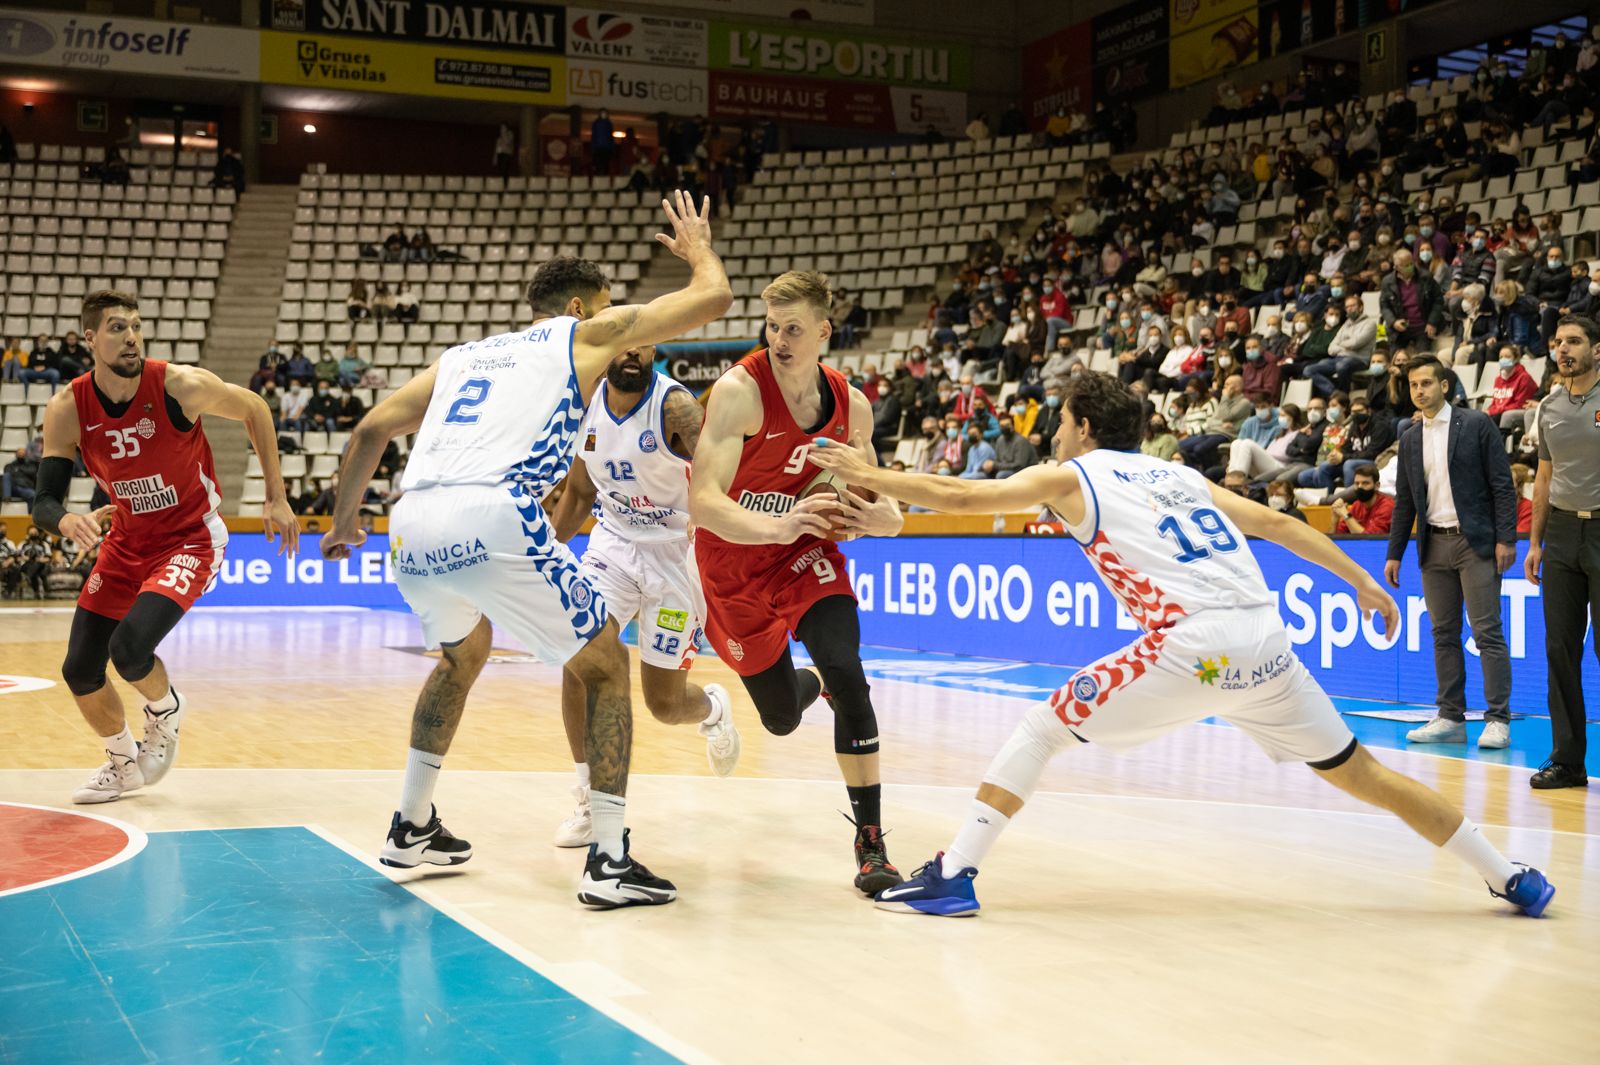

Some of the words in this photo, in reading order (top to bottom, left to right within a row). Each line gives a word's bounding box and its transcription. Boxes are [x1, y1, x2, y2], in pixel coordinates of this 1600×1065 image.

[321, 0, 411, 35] SANT
[425, 4, 557, 47] DALMAI
[62, 19, 191, 56] infoself
[572, 41, 633, 57] VALENT
[61, 51, 110, 67] group
[319, 47, 371, 64] Grues
[729, 31, 949, 83] L'ESPORTIU
[319, 64, 386, 82] Viñolas
[608, 73, 703, 103] fustech
[718, 84, 827, 108] BAUHAUS
[909, 94, 923, 123] 5
[443, 377, 495, 425] 2
[105, 427, 141, 460] 35
[605, 459, 636, 481] 12
[783, 445, 809, 474] 9
[113, 476, 164, 497] ORGULL
[131, 487, 177, 512] GIRONÍ
[1155, 507, 1239, 564] 19
[286, 551, 324, 584] la
[400, 549, 415, 566] LA
[400, 565, 428, 577] CIUDAD
[432, 565, 447, 576] DEL
[447, 553, 490, 572] DEPORTE
[157, 565, 196, 596] 35
[812, 558, 837, 585] 9
[849, 559, 874, 612] la
[884, 562, 937, 616] LEB
[948, 563, 1033, 623] ORO
[1047, 580, 1099, 628] en
[660, 614, 685, 628] CRC
[652, 632, 680, 656] 12
[1224, 667, 1241, 681] LA
